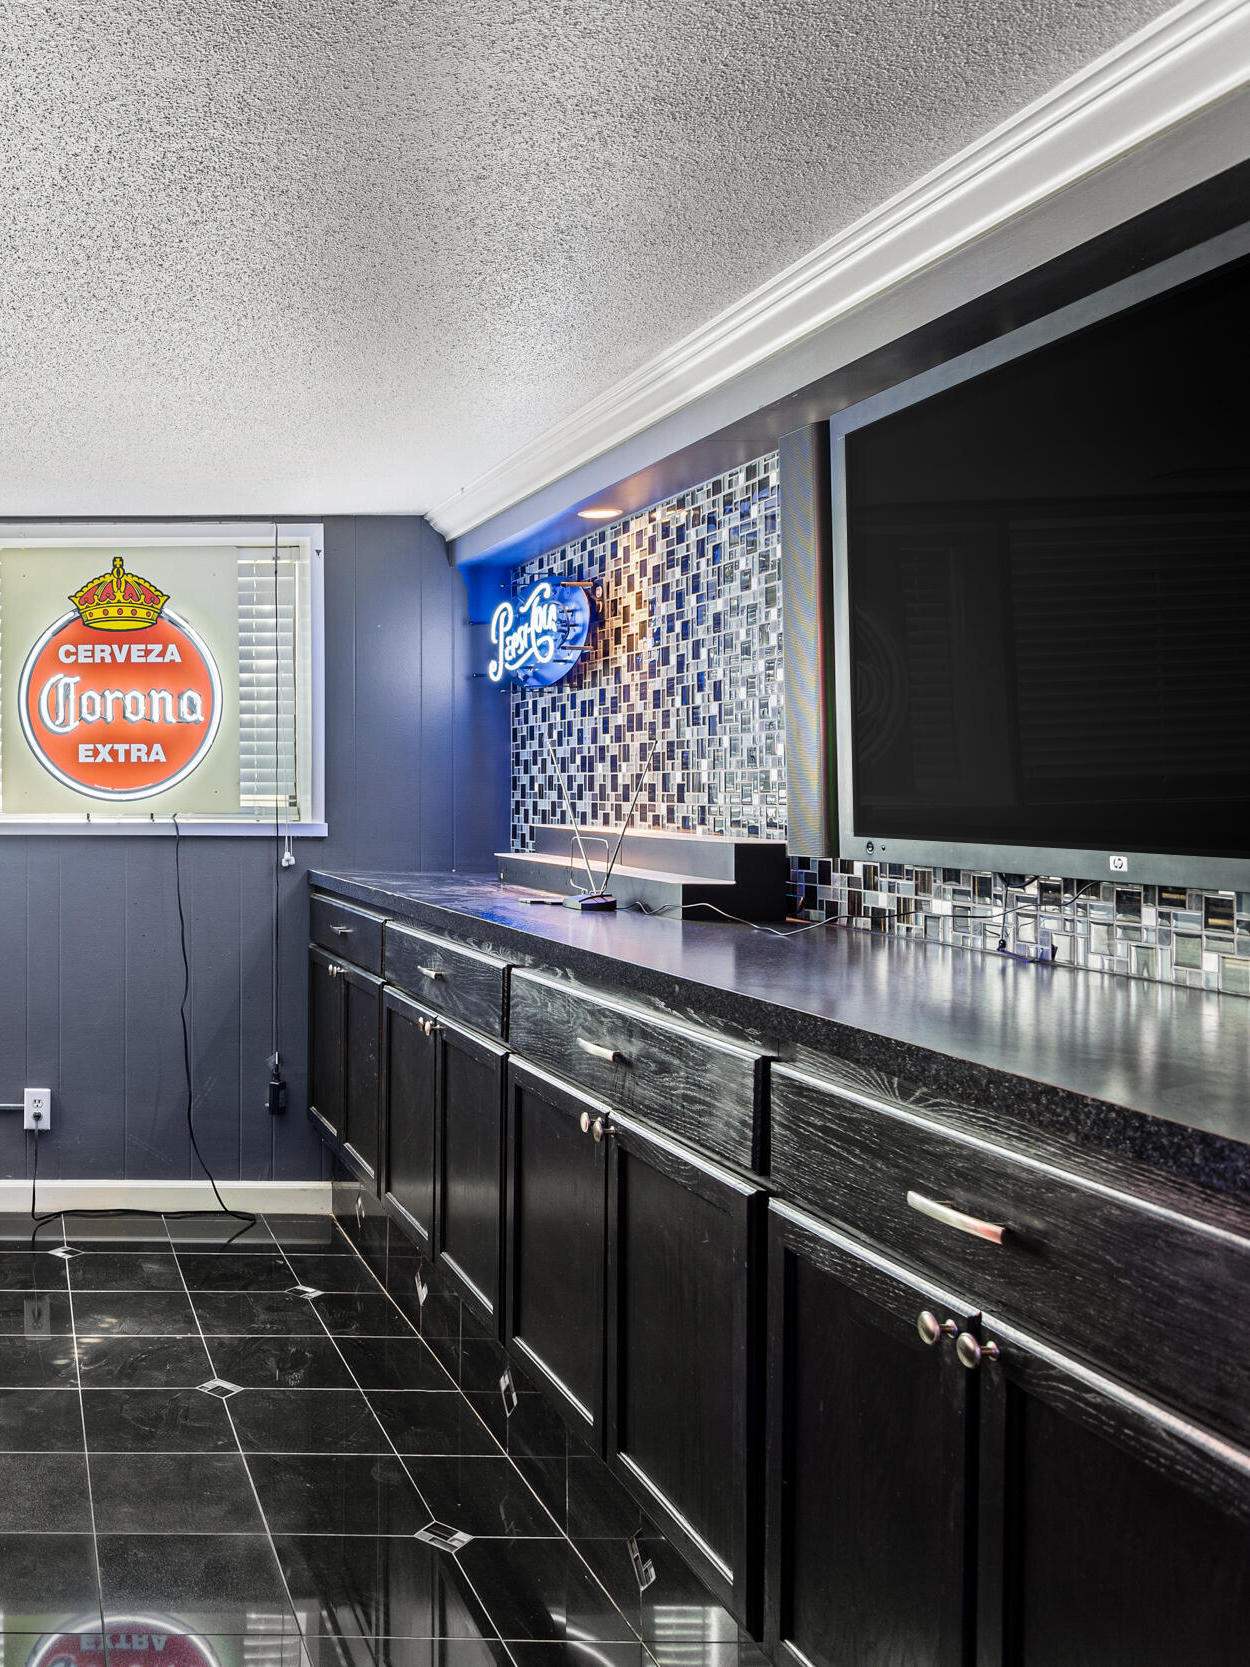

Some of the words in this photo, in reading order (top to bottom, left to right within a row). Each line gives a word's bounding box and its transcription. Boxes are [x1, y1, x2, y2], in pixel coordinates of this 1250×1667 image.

[58, 643, 182, 664] CERVEZA
[37, 672, 205, 736] Corona
[78, 743, 167, 763] EXTRA
